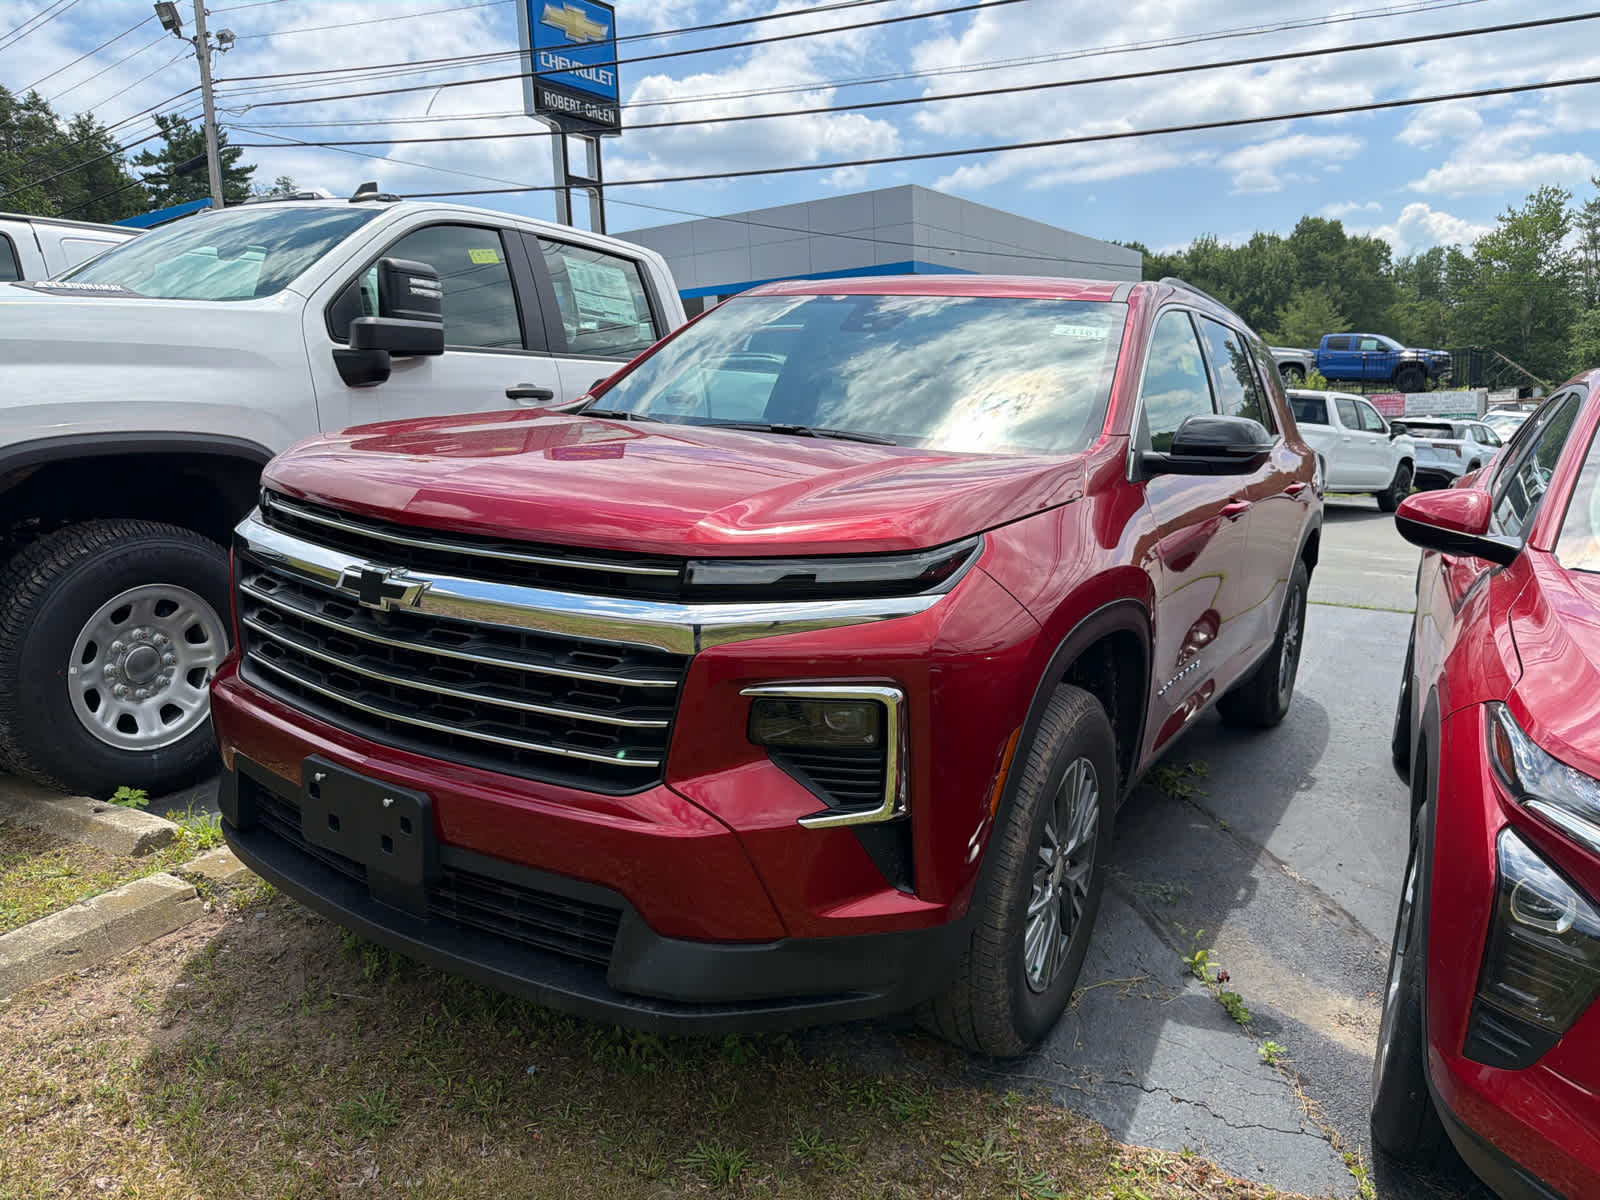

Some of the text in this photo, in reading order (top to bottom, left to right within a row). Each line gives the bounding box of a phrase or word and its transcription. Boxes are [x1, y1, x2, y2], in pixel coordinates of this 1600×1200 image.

[540, 51, 614, 86] CHEVROLET
[544, 91, 615, 123] ROBERT GREEN
